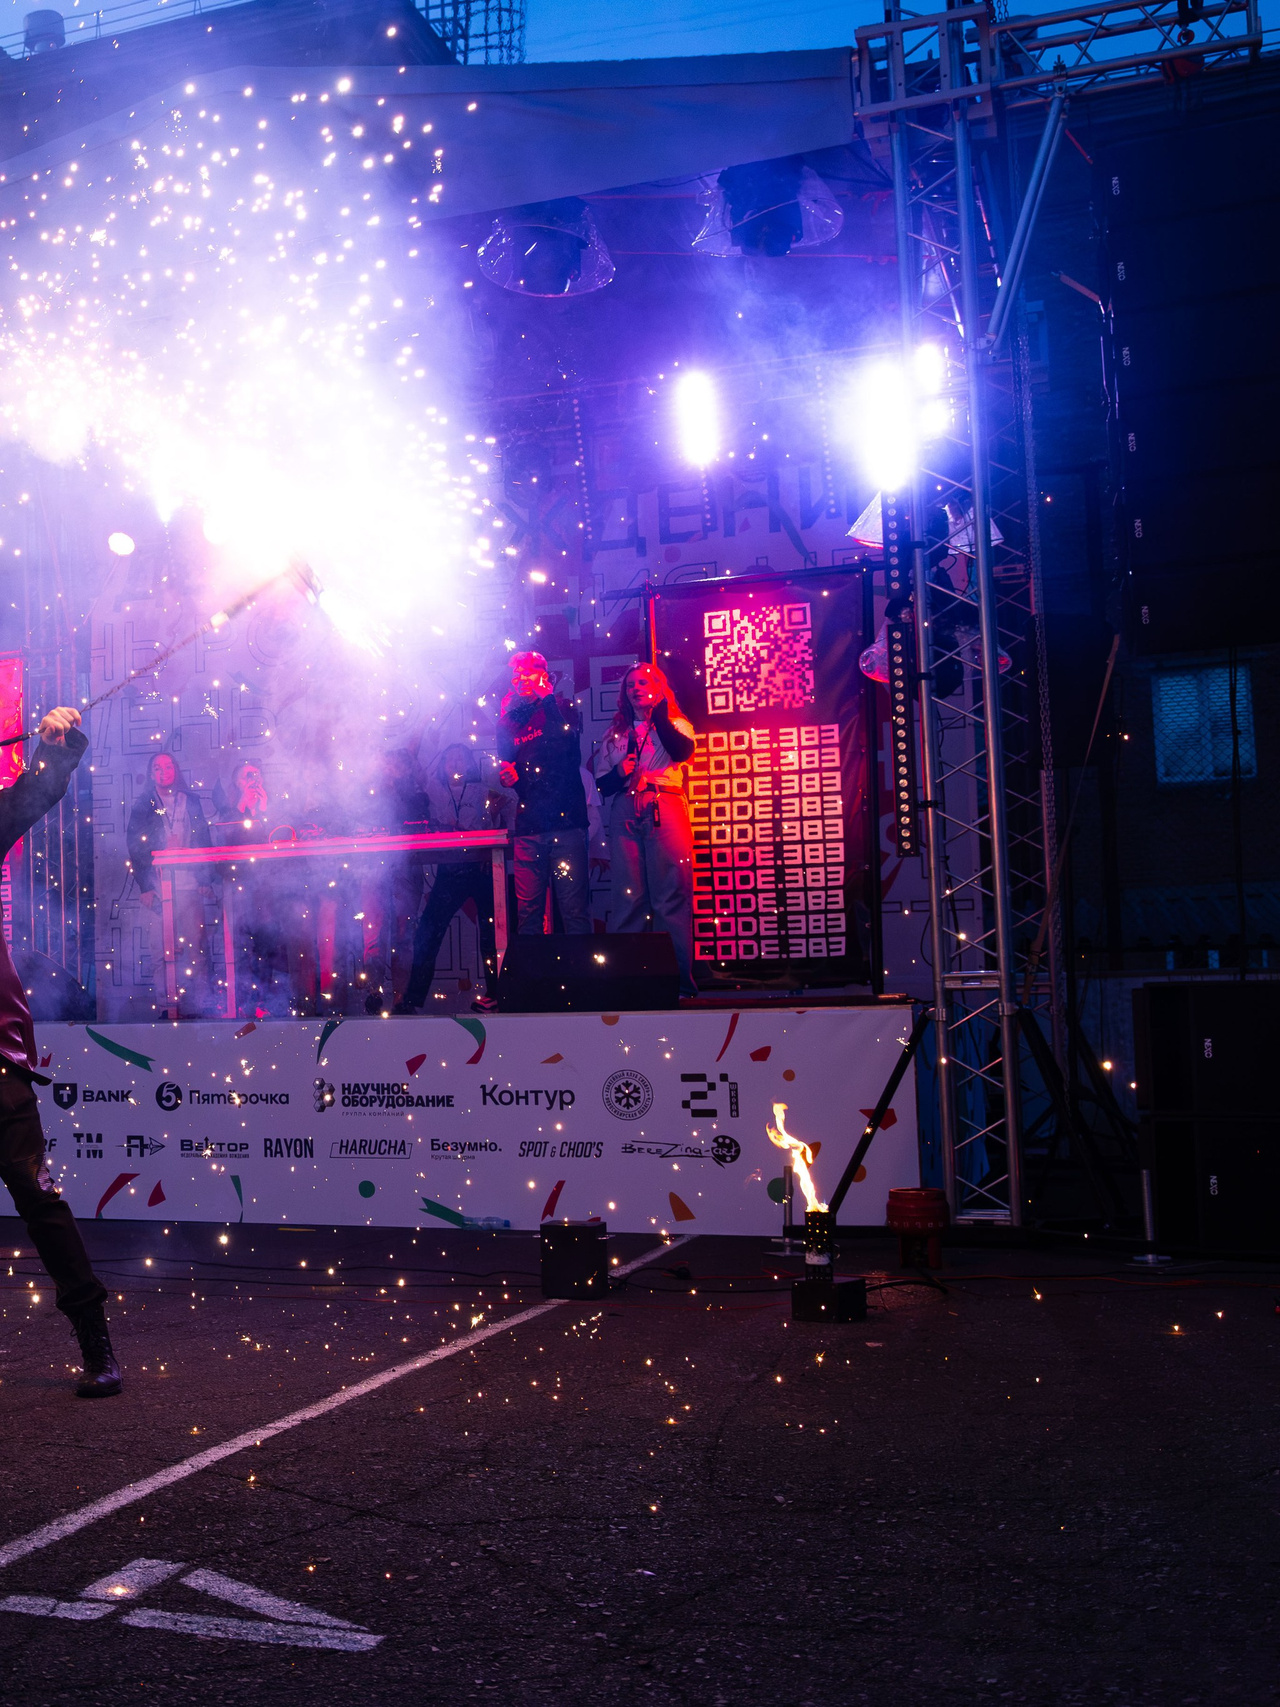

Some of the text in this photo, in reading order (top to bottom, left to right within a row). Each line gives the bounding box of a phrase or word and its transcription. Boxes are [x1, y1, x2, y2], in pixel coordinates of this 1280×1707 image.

[1111, 176, 1120, 196] NEXO
[1117, 261, 1126, 282] NEXO
[1122, 346, 1131, 367] NEXO
[1128, 432, 1136, 452] NEXO
[1134, 518, 1143, 539] NEXO
[1141, 605, 1150, 625] NEXO
[688, 746, 841, 777] CODE.383
[688, 771, 842, 800] CODE.383
[689, 795, 843, 822] CODE.383
[691, 818, 844, 846] CODE.383
[692, 842, 845, 869] CODE.383
[692, 865, 845, 892] CODE.383
[692, 889, 845, 915] CODE.383
[693, 912, 846, 938] CODE.383
[694, 935, 847, 961] CODE.383
[1203, 1037, 1213, 1059] NEXO
[82, 1090, 133, 1102] BANK
[341, 1082, 410, 1095] НАУЧНОЕ
[480, 1084, 576, 1110] Контур
[189, 1090, 290, 1109] Пятёрочка
[341, 1095, 455, 1109] ОБОРУДОВАНИЕ
[263, 1138, 314, 1159] RAYON
[338, 1139, 407, 1156] HARUCHA
[430, 1138, 502, 1154] Безумно.
[518, 1141, 604, 1158] SPOT & CHOO'S
[1209, 1174, 1219, 1196] NEXO
